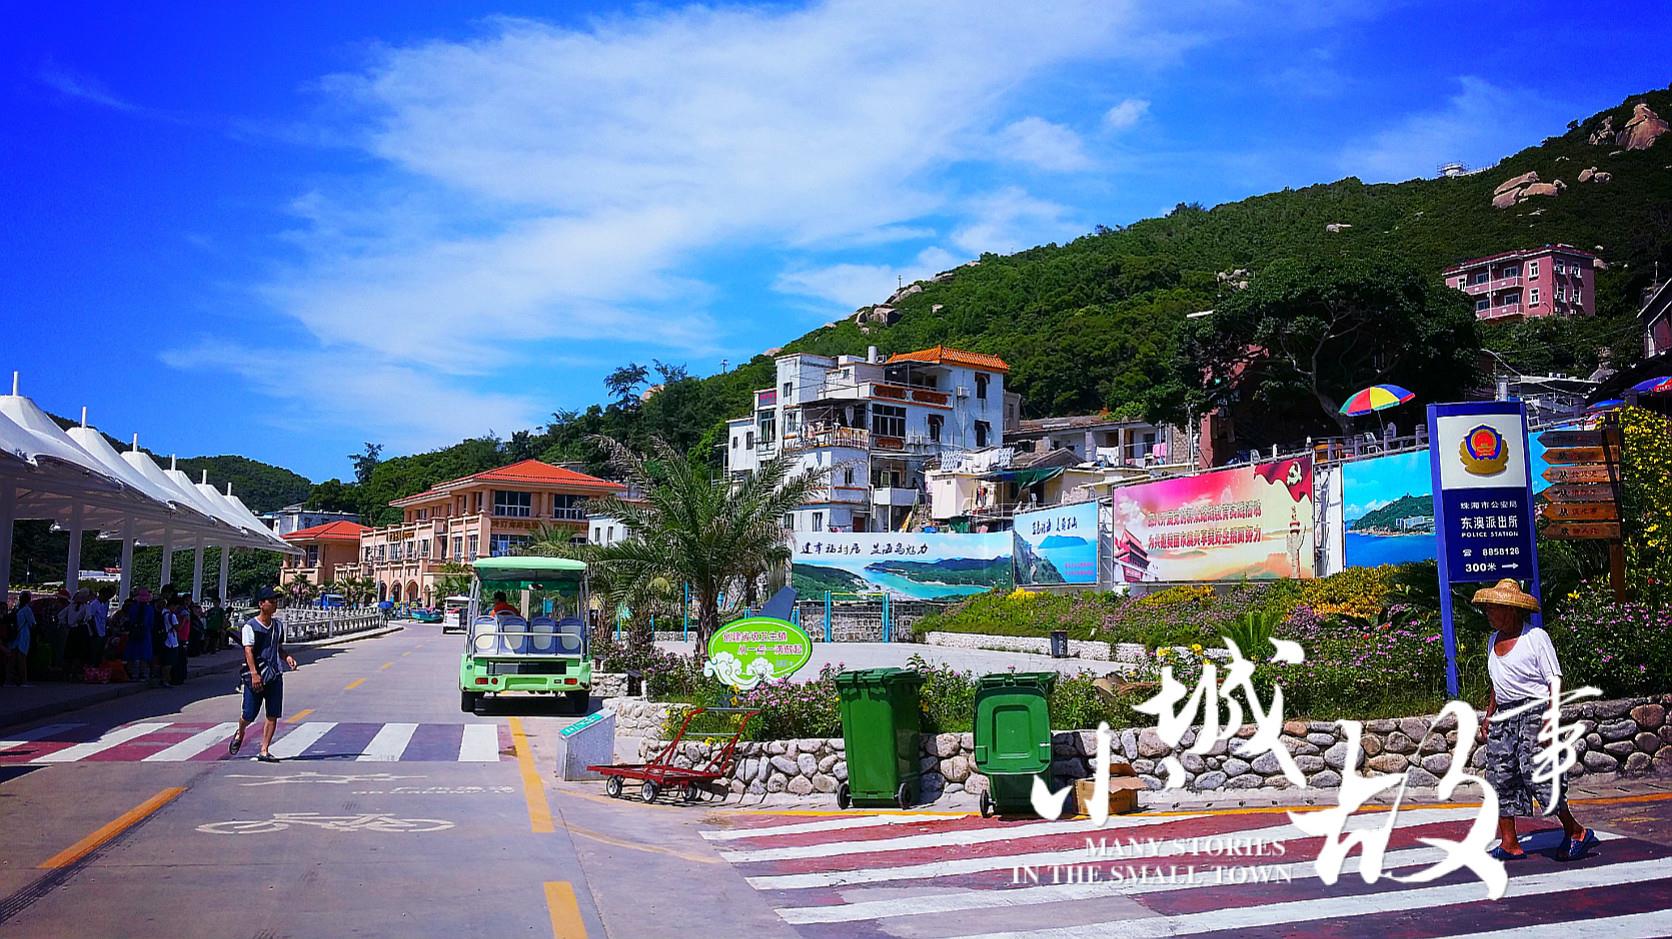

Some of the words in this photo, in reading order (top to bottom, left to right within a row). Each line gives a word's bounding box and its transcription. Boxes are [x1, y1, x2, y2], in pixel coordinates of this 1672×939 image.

[1460, 500, 1517, 509] 珠海市公安局
[1460, 515, 1517, 529] 东澳派出所
[1465, 562, 1497, 573] 300米
